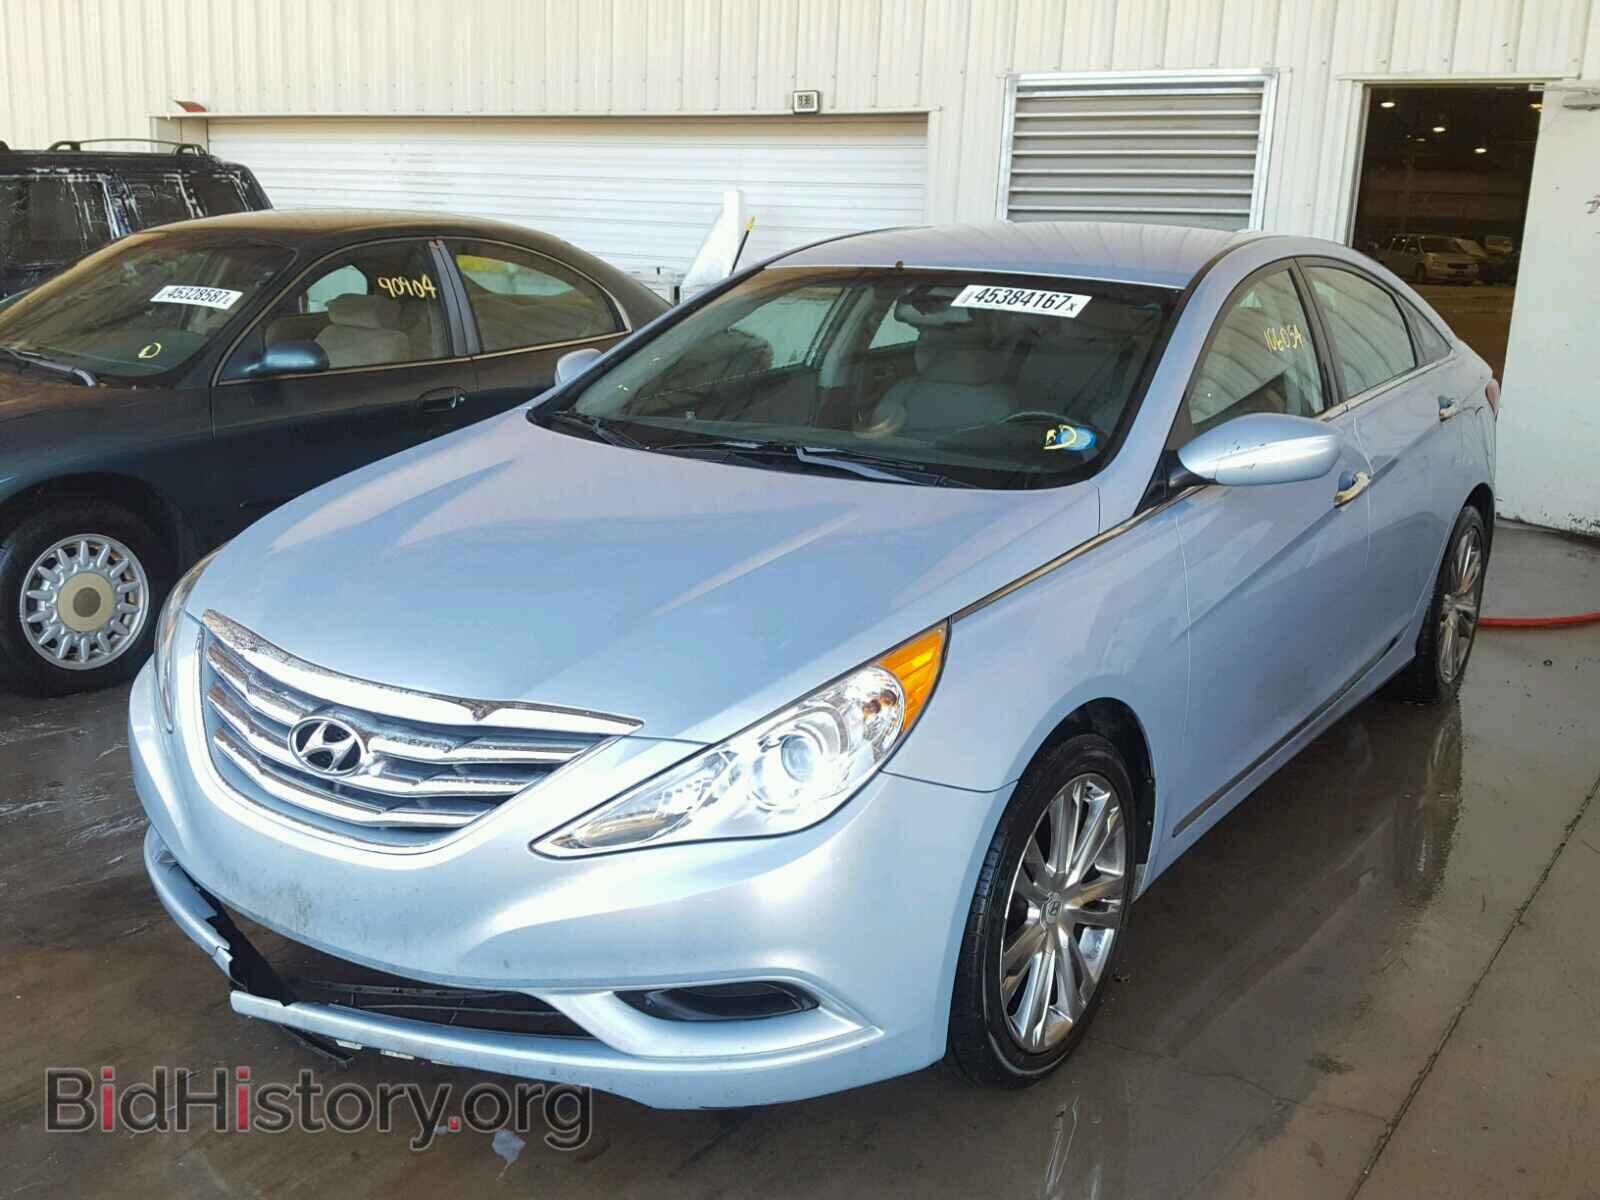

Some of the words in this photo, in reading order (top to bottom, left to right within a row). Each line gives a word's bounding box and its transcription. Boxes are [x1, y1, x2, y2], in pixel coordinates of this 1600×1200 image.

[167, 287, 230, 304] 45328587
[377, 274, 437, 299] 90904
[974, 287, 1072, 310] 45384167
